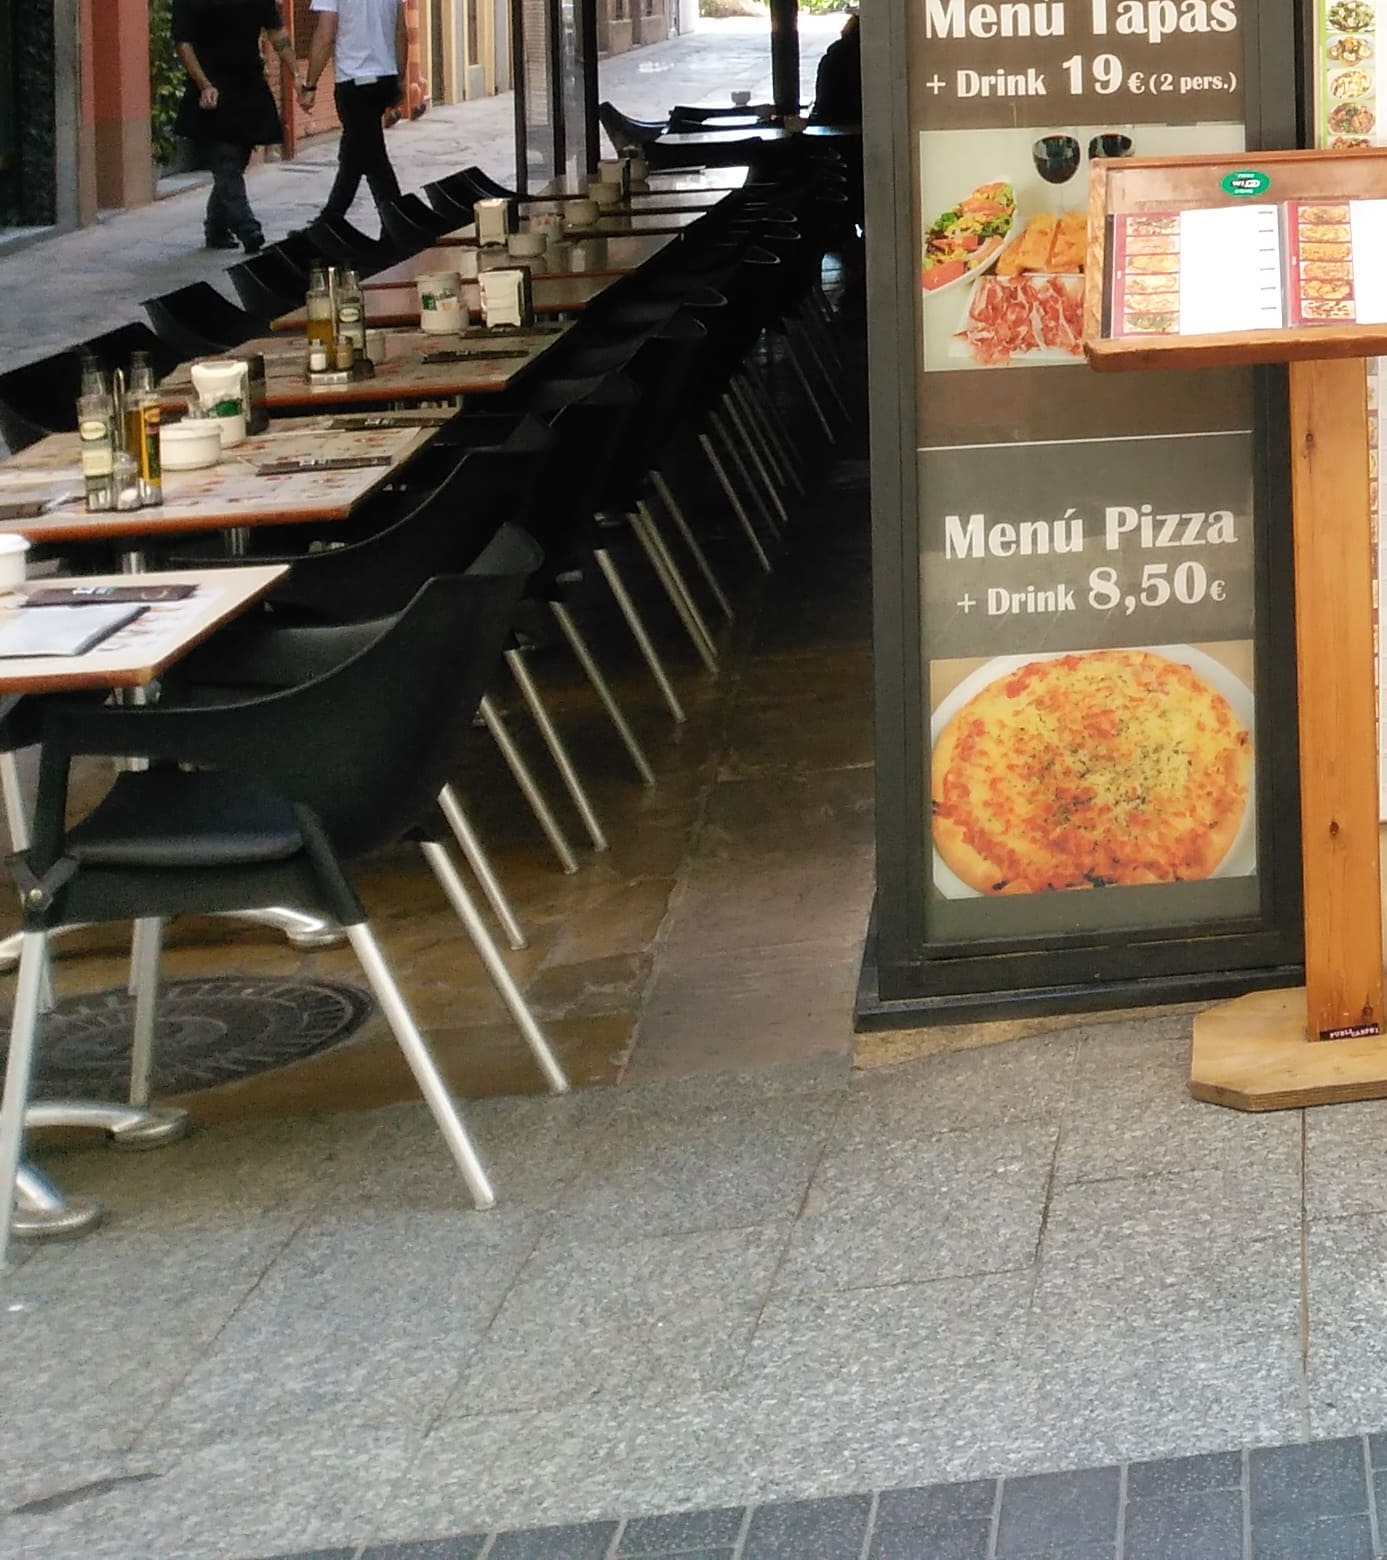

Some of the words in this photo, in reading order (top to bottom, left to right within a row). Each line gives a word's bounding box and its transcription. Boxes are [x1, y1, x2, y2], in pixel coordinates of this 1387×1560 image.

[957, 68, 1047, 98] Drink
[944, 508, 1085, 560] Menú
[1105, 504, 1239, 551] Pizza
[987, 584, 1077, 616] Drink
